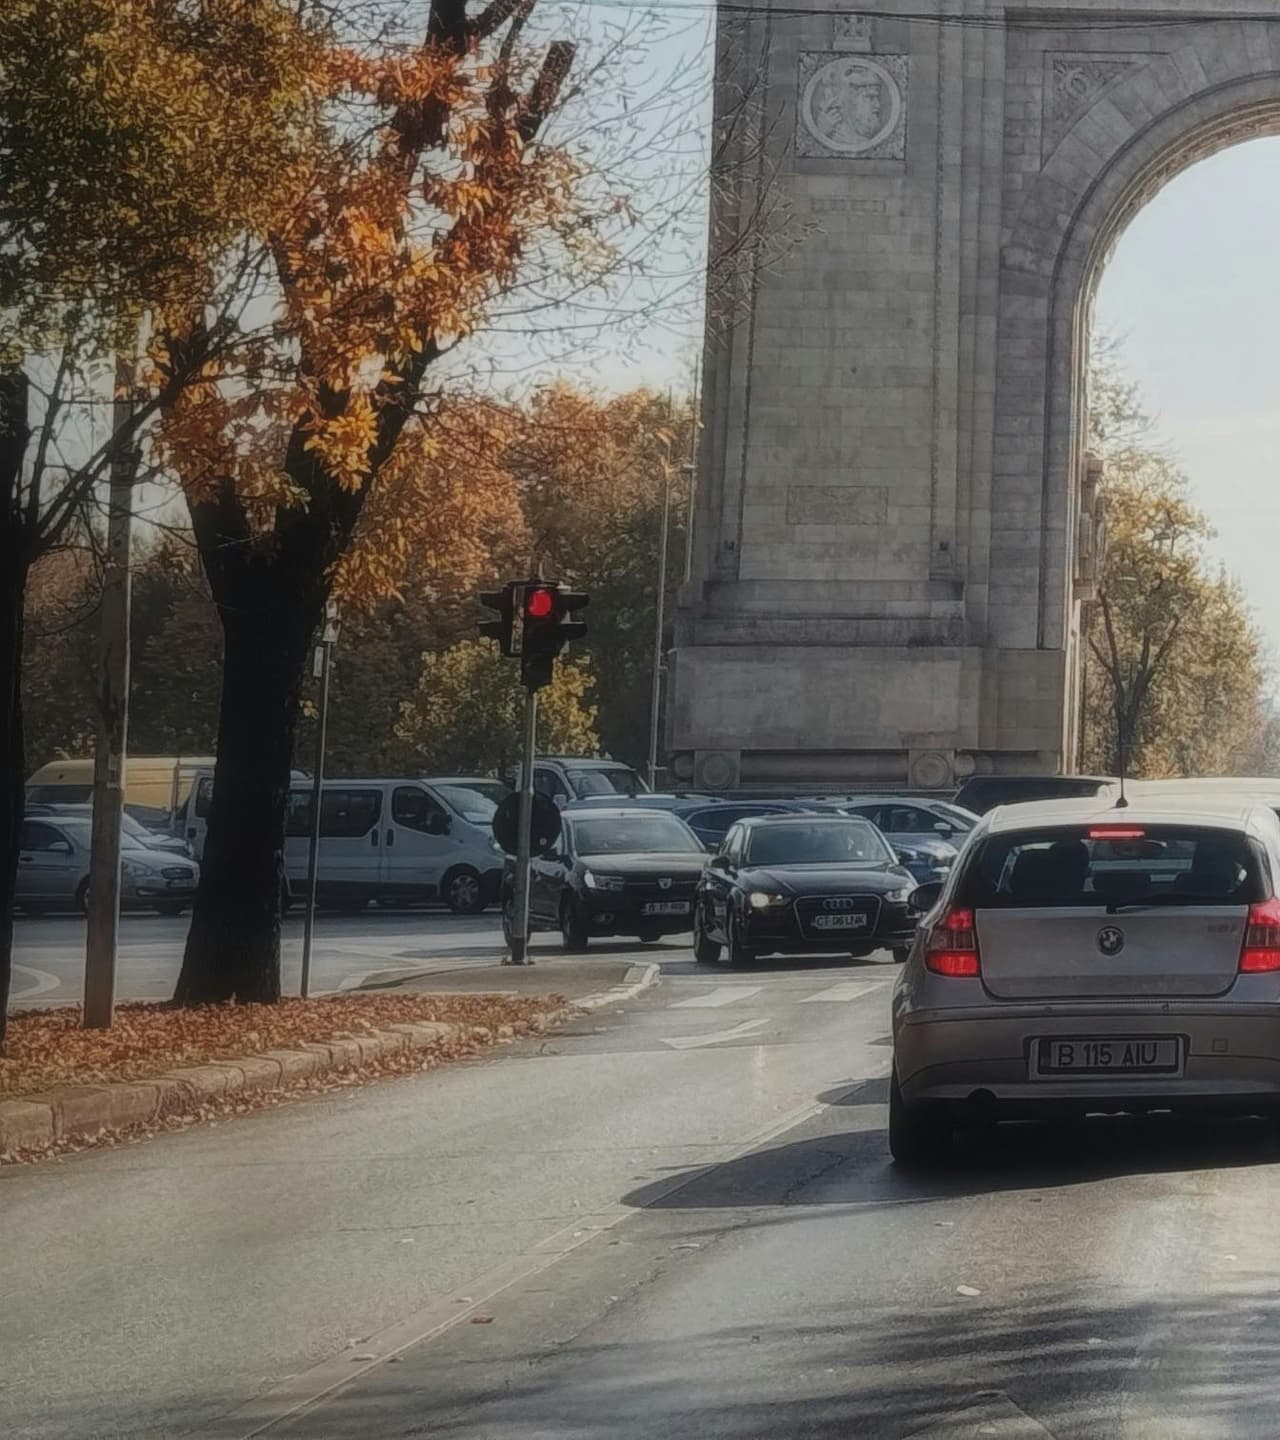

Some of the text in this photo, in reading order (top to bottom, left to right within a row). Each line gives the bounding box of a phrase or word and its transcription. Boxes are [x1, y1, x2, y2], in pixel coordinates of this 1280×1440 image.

[1058, 1042, 1158, 1066] B 115 AIU
